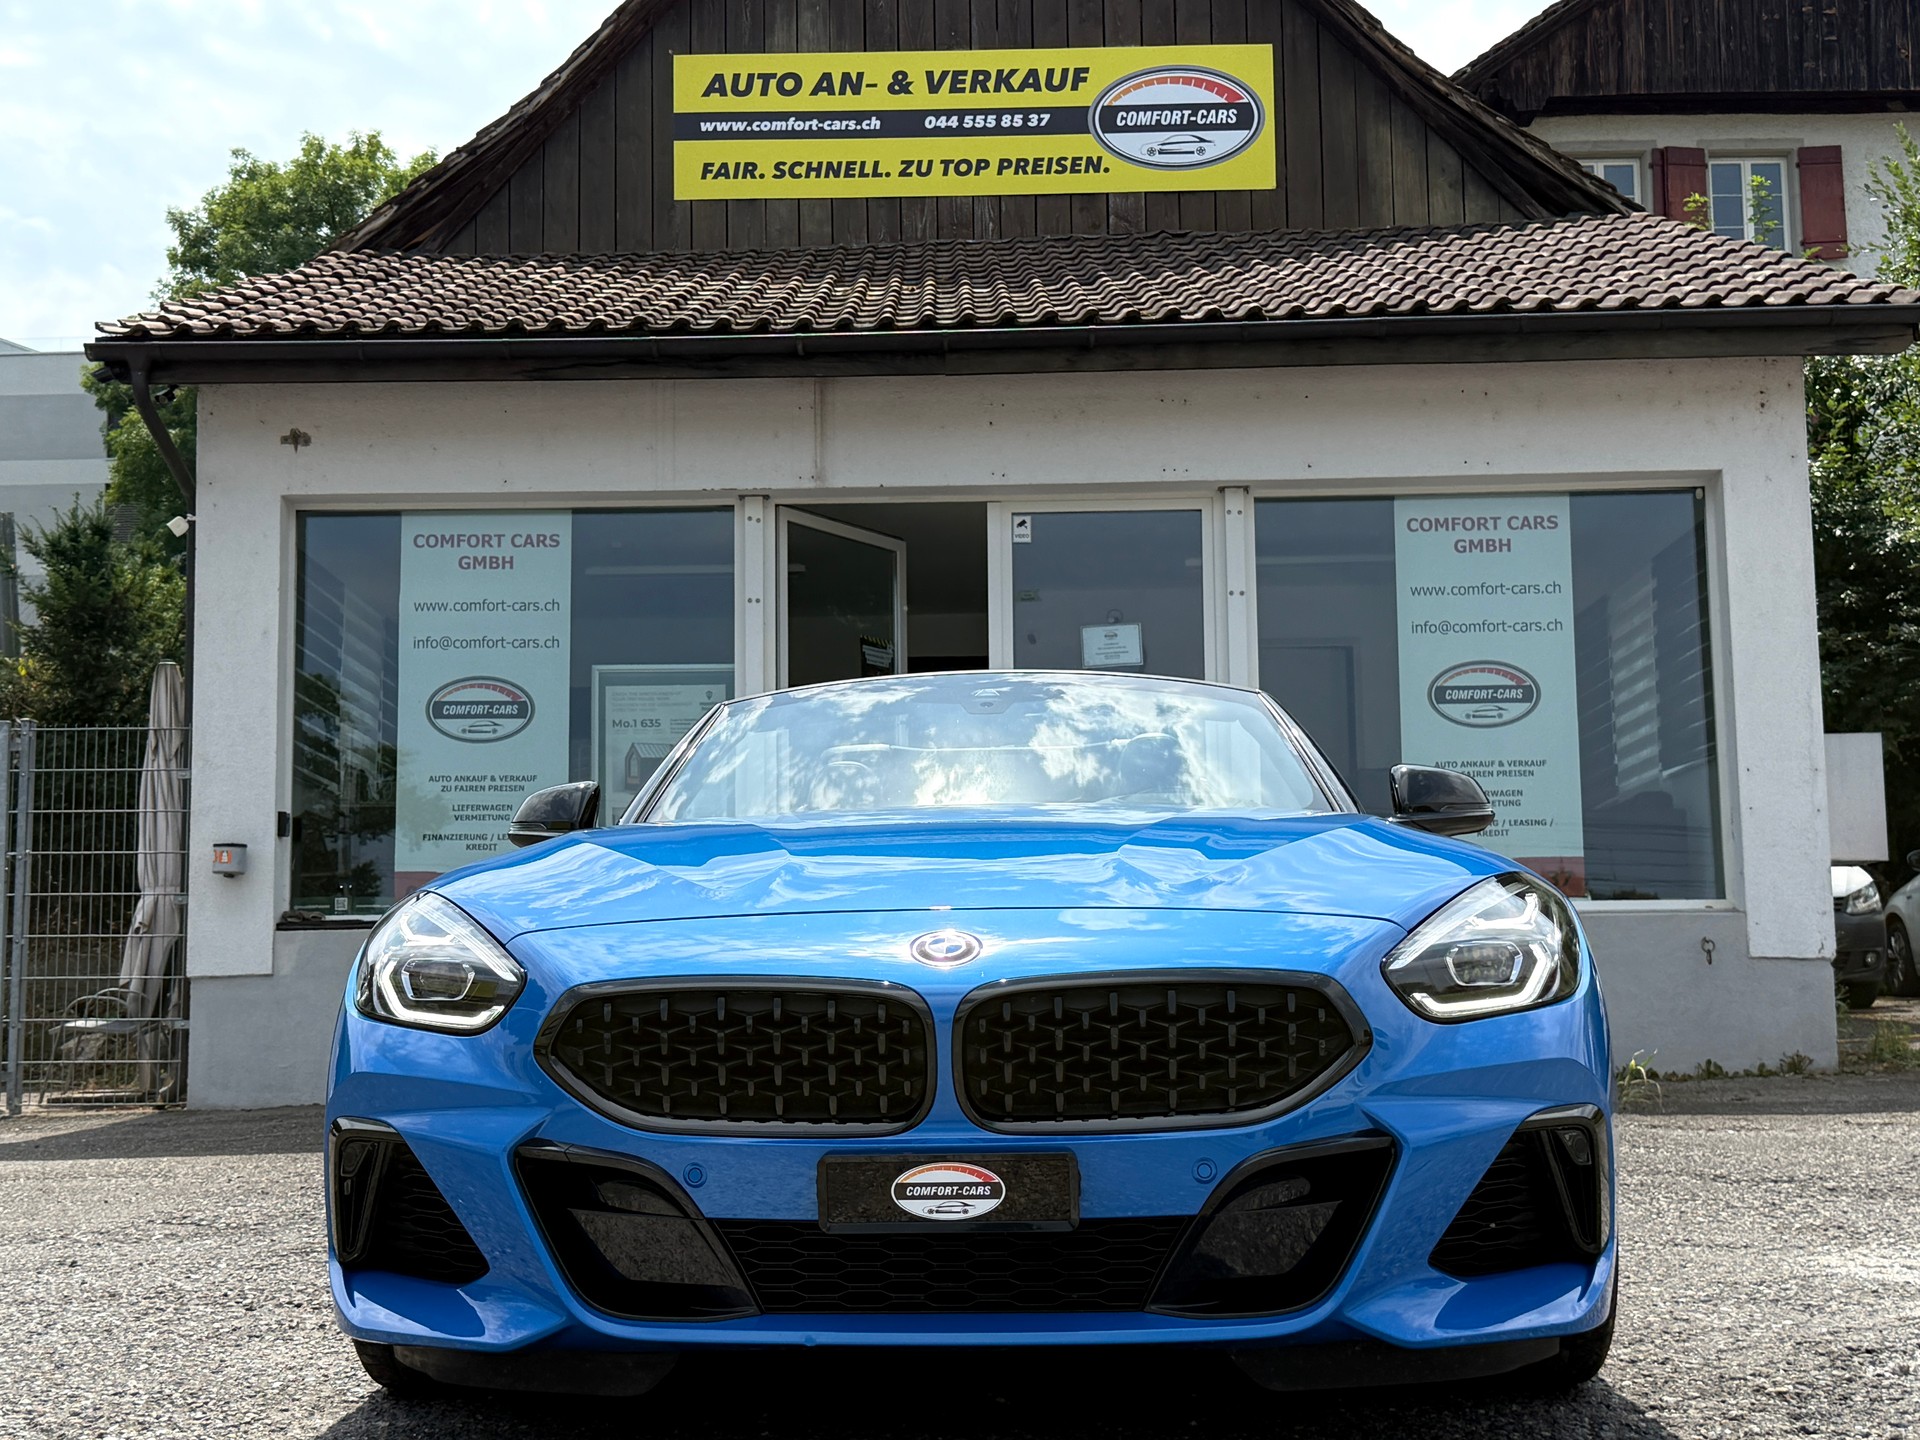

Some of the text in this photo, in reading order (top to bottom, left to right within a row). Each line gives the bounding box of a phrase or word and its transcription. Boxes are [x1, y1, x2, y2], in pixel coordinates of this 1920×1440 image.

[701, 67, 1090, 97] AUTO AN- & VERKAUF
[700, 117, 881, 131] www.comfort-cars.ch
[924, 113, 1050, 129] 044 555 85 37
[1115, 107, 1237, 128] COMFORT-CARS
[701, 155, 1110, 180] FAIR. SCHNELL. ZU TOP PREISEN.
[1406, 515, 1559, 532] COMFORT CARS
[413, 533, 560, 548] COMFORT CARS
[1454, 538, 1511, 553] GMBH
[458, 555, 514, 570] GMBH
[1410, 581, 1562, 596] www.comfort-cars.ch
[414, 599, 560, 612] www.comfort-cars.ch
[1411, 618, 1563, 635] info@comfort-cars.ch
[413, 635, 560, 651] info@comfort-cars.ch
[1445, 687, 1523, 700] COMFORT-CARS
[442, 704, 519, 716] COMFORT-CARS
[640, 719, 661, 728] 635
[1434, 761, 1458, 769] AUTO
[1460, 760, 1495, 768] ANKAUF
[1507, 759, 1547, 767] VERKAUF
[428, 775, 452, 783] AUTO
[454, 775, 488, 783] ANKAUF
[499, 774, 537, 782] VERKAUF
[1496, 769, 1534, 777] PREISEN
[488, 784, 525, 792] PREISEN
[452, 804, 513, 812] LIEFERWAGEN
[1508, 818, 1547, 827] LEASING
[422, 833, 488, 841] FINANZIERUNG
[466, 843, 498, 851] KREDIT
[906, 1185, 991, 1196] COMFORT-CARS
